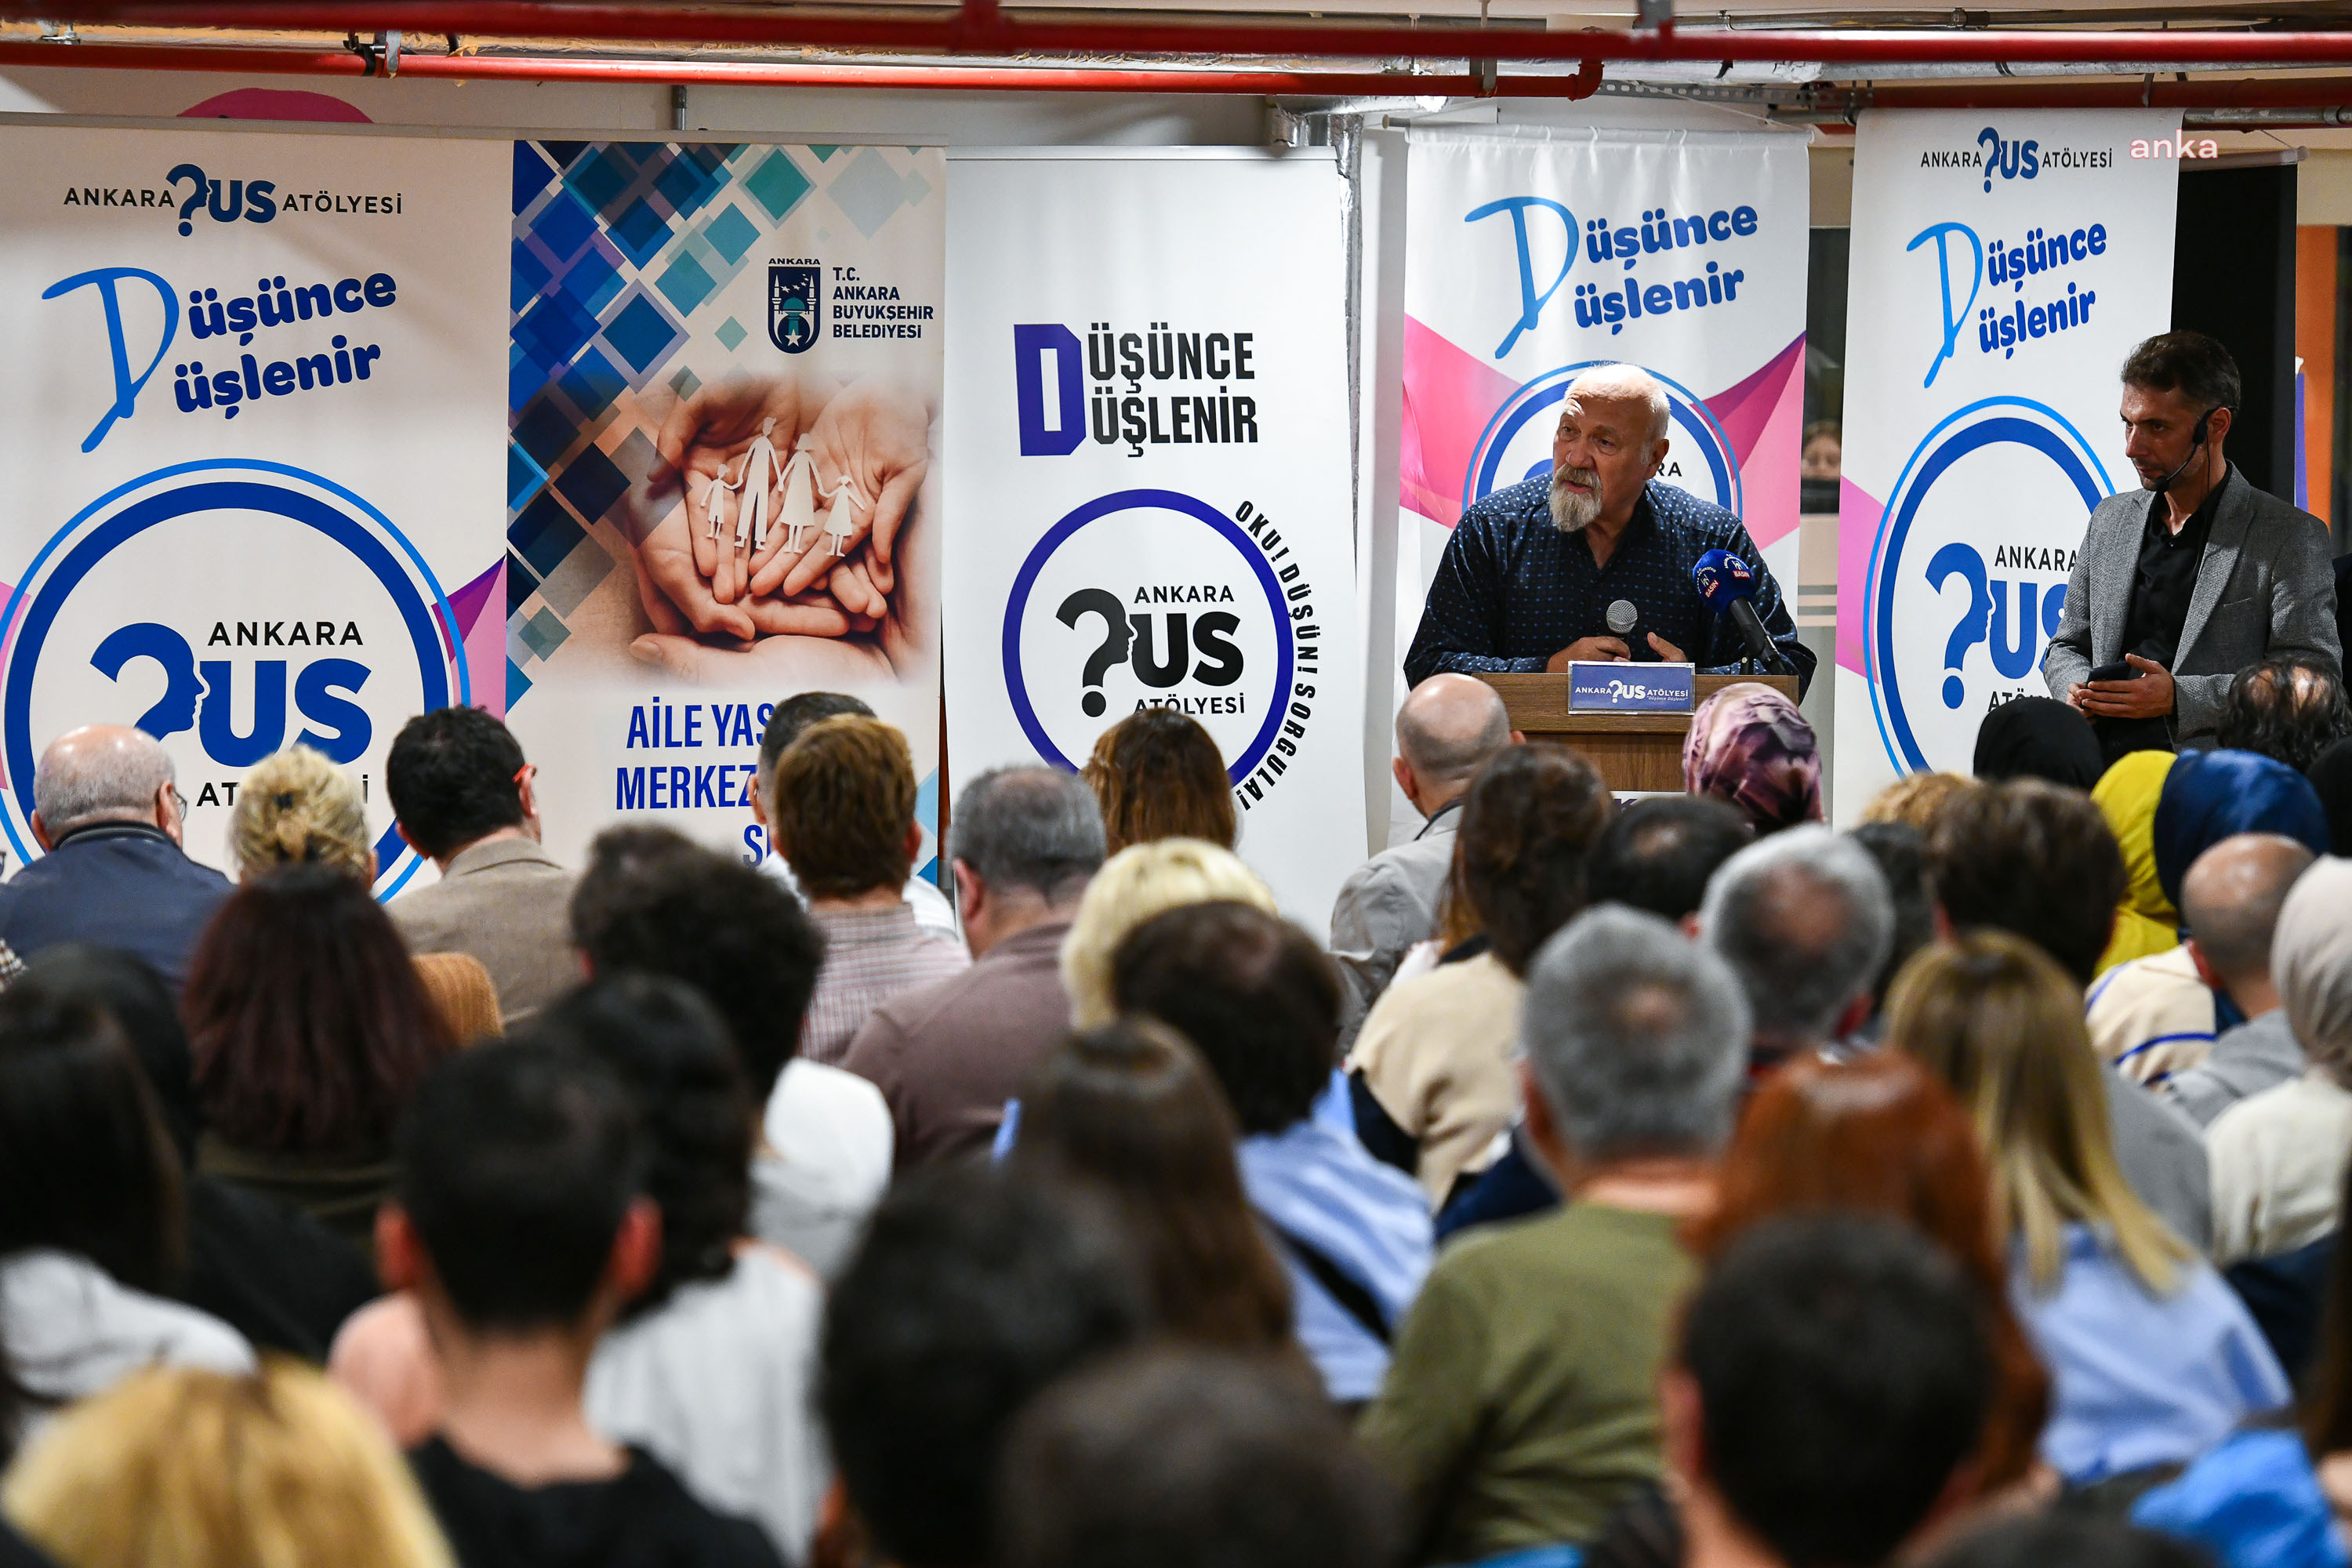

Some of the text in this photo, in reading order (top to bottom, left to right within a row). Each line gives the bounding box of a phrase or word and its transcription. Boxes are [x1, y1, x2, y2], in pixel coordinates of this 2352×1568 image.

[1921, 151, 1983, 168] ANKARA
[2042, 147, 2112, 169] ATÖLYESİ
[64, 187, 175, 209] ANKARA
[282, 191, 402, 215] ATÖLYESİ
[768, 257, 821, 266] ANKARA
[833, 267, 860, 281] T.C.
[833, 285, 901, 301] ANKARA
[833, 304, 934, 321] BÜYÜKŞEHİR
[833, 324, 922, 339] BELEDİYESİ
[1994, 545, 2077, 572] ANKARA
[1134, 585, 1235, 604] ANKARA
[207, 621, 364, 647] ANKARA
[1235, 500, 1321, 811] OKU! DÜŞÜN! SORGULA!
[1574, 686, 1613, 695] ANKARA
[1646, 688, 1689, 697] ATÖLYESİ
[1134, 692, 1245, 715] ATÖLYESİ
[626, 696, 703, 749] AİLE
